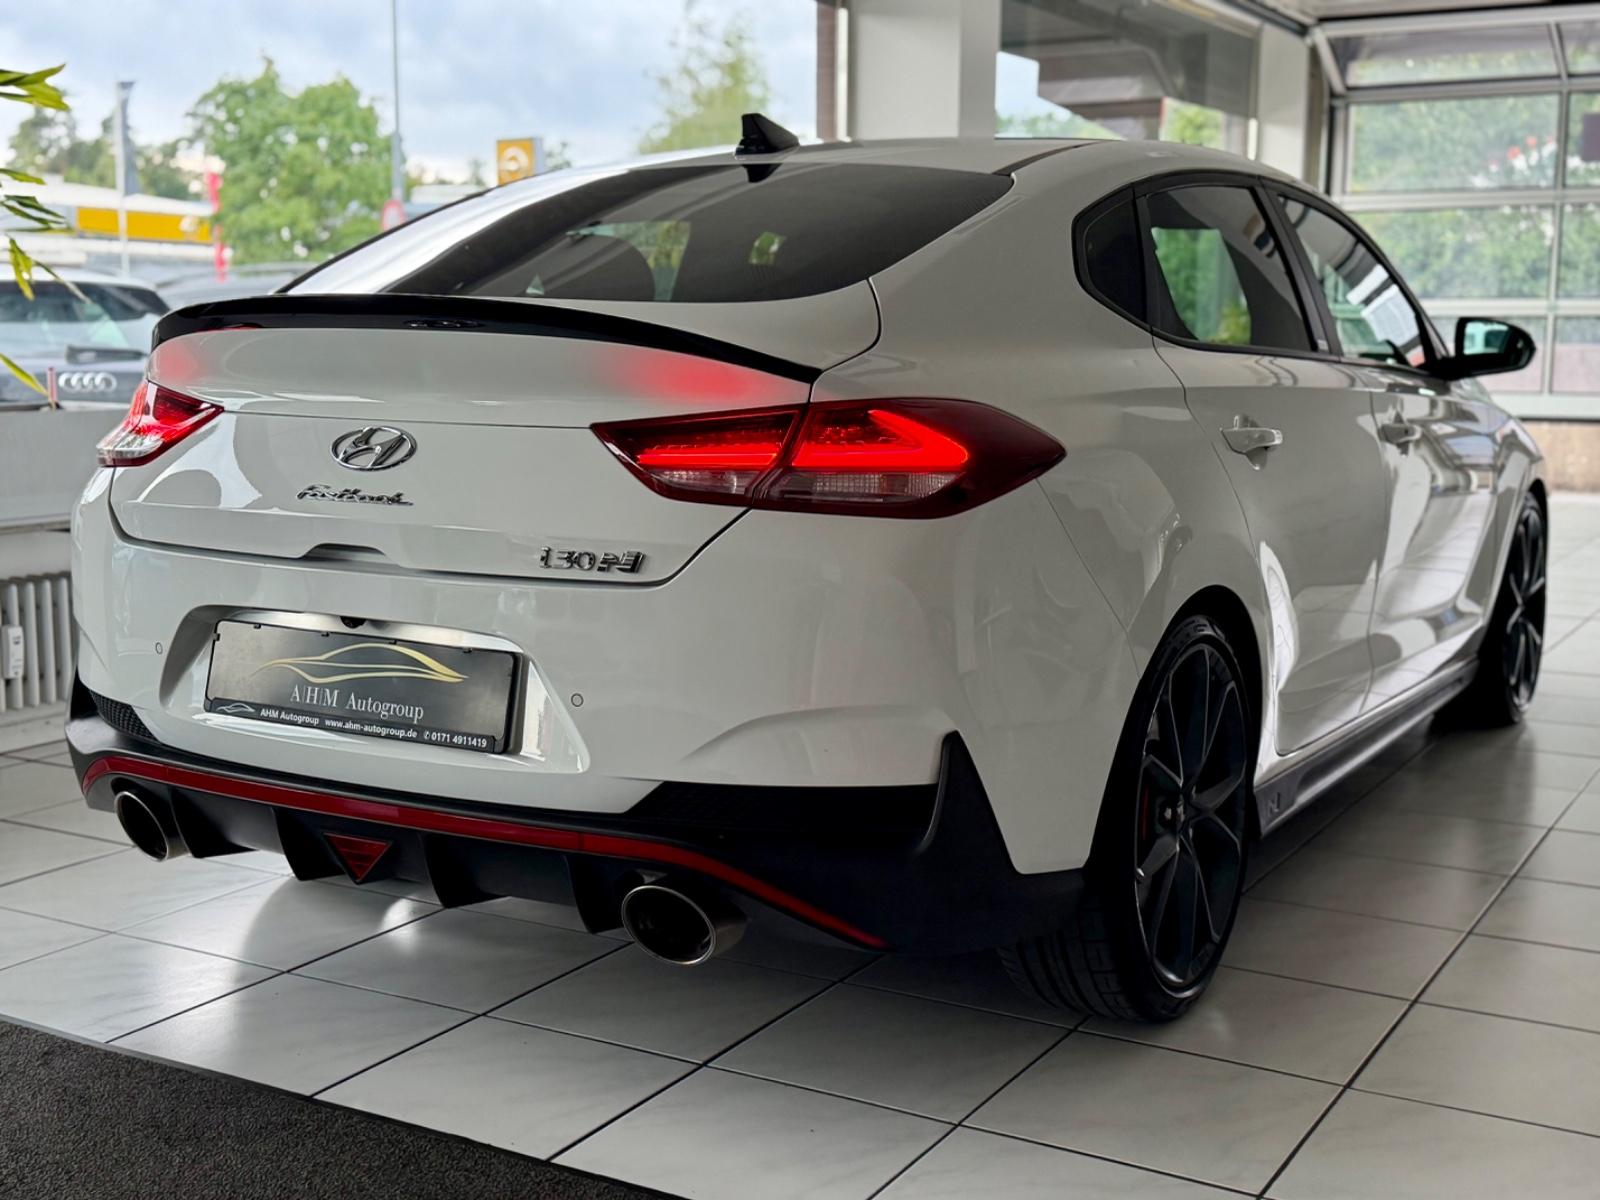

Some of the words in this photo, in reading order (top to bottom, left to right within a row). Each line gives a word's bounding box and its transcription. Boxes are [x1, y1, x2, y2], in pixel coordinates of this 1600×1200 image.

[346, 692, 424, 724] Autogroup
[260, 708, 279, 719] AHM
[280, 711, 319, 726] Autogroup
[325, 718, 417, 739] www.ahm-autogroup.de
[431, 732, 450, 742] 0171
[452, 735, 487, 747] 4911419
